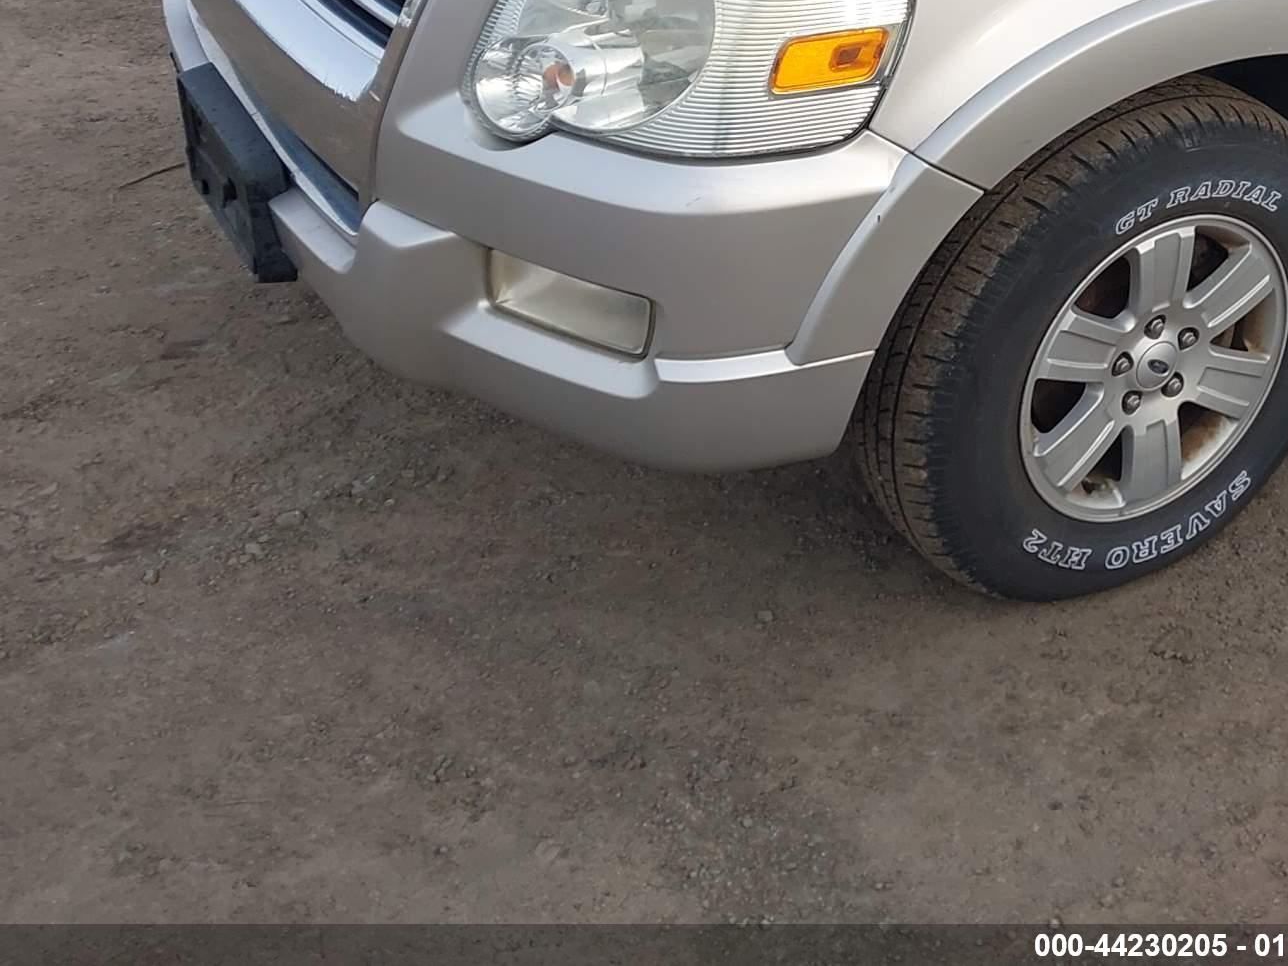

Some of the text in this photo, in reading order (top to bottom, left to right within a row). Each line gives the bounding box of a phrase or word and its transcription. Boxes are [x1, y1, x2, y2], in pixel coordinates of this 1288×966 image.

[1115, 179, 1282, 235] GT RADIAL
[1022, 469, 1252, 571] SAVERO HT2
